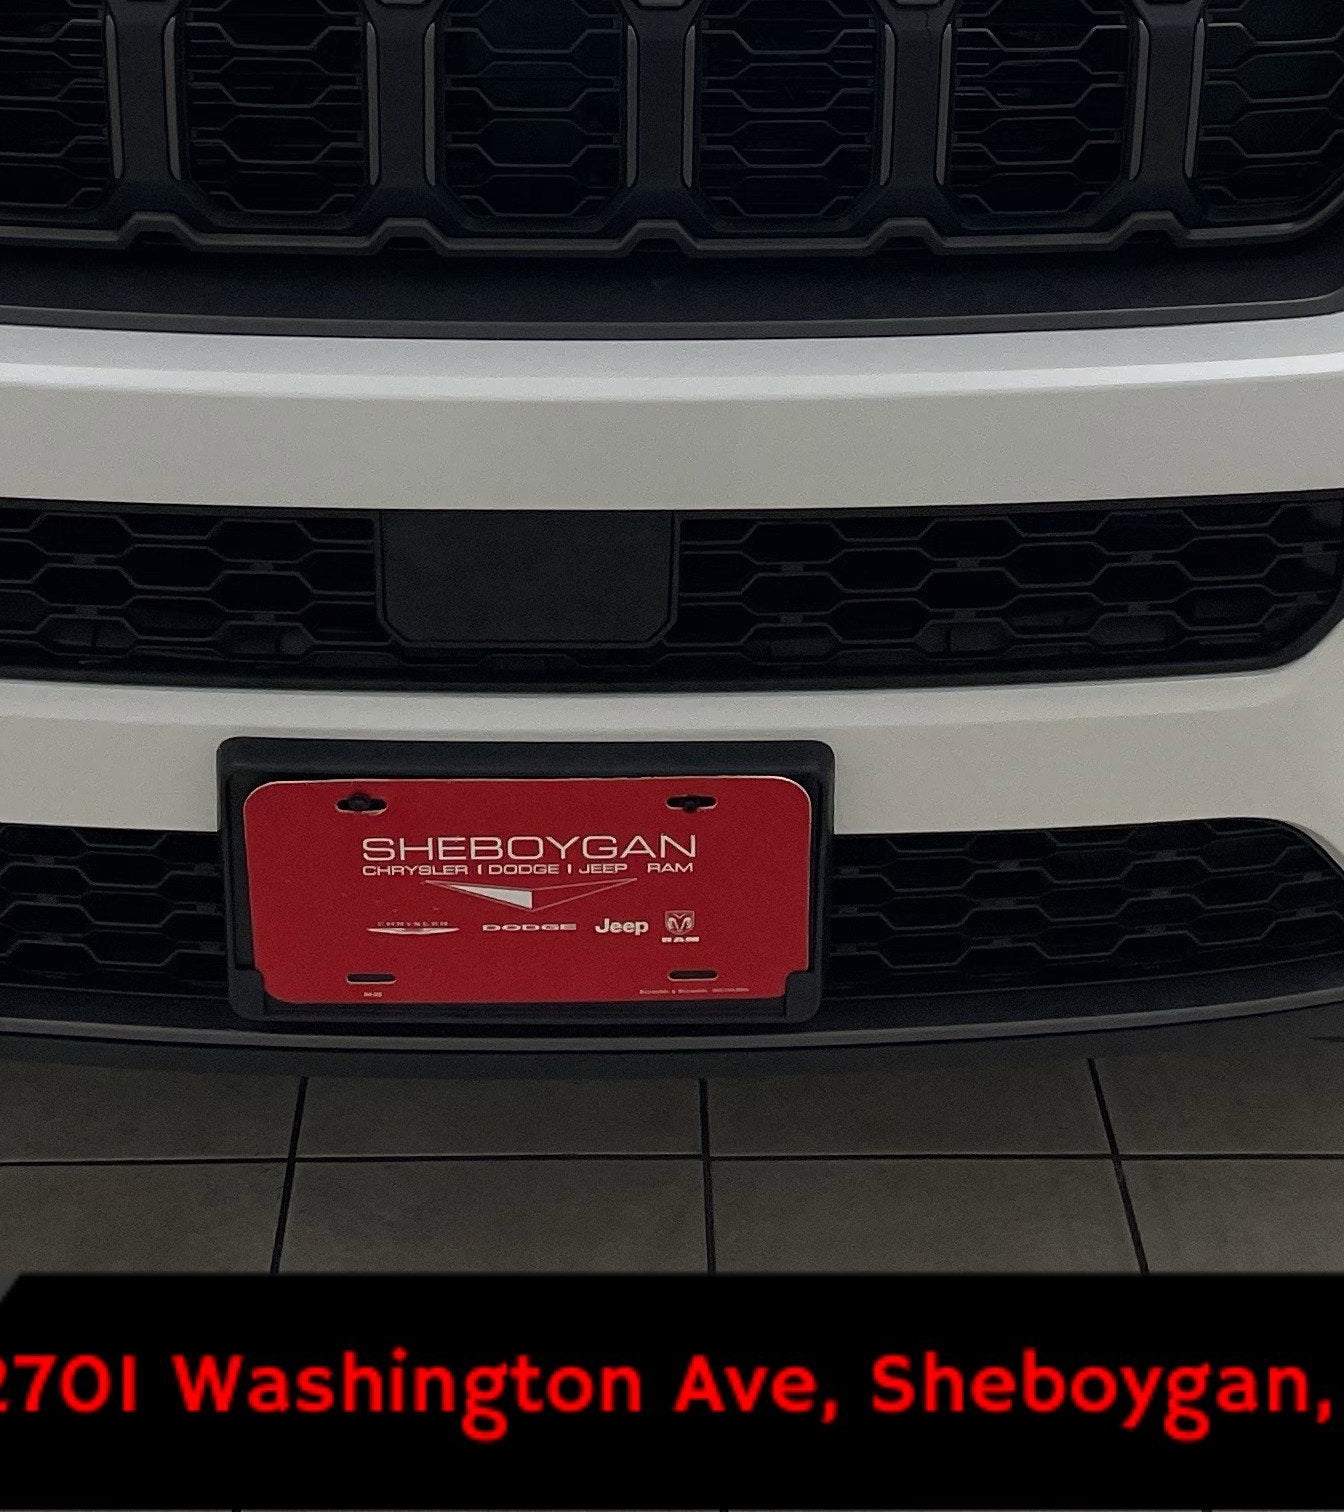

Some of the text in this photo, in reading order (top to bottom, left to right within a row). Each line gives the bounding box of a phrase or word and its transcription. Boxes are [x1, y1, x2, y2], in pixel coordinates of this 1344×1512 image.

[362, 834, 696, 861] SHEBOYGAN
[362, 862, 694, 876] CHRYSLER DODGE JEEP RAM
[482, 922, 577, 932] DODGE
[594, 917, 649, 936] Jeep
